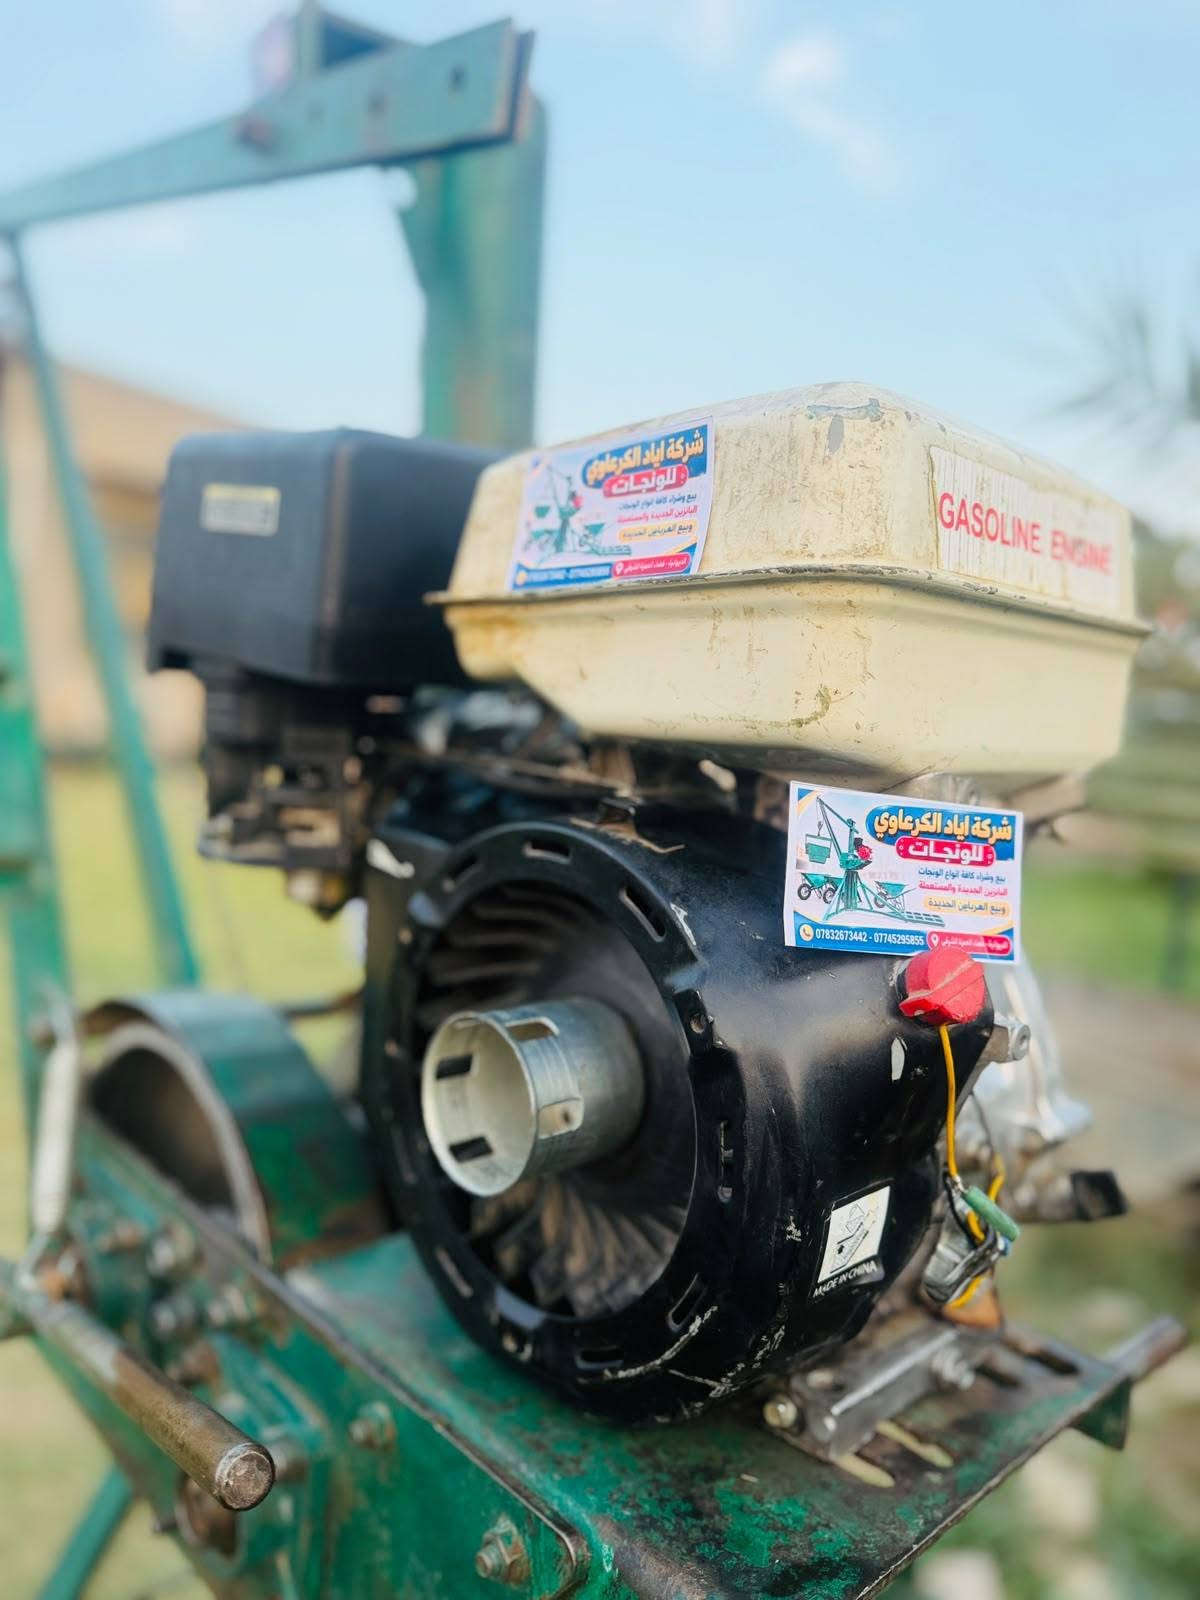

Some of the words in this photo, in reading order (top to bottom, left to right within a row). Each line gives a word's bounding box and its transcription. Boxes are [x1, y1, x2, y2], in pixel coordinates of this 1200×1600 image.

[643, 440, 666, 468] اياد
[667, 429, 704, 463] شركة
[611, 467, 677, 494] للونجات
[938, 492, 1041, 554] GASOLINE
[1051, 529, 1113, 576] ENGINE
[874, 808, 942, 839] الكرعاوي
[943, 813, 970, 841] اياد
[971, 816, 1012, 845] شركة
[908, 840, 985, 865] للونجات
[961, 869, 975, 879] كافة
[976, 871, 994, 883] وشراء
[995, 875, 1007, 884] بيع
[815, 928, 868, 942] 07832673442
[873, 932, 925, 945] 07745295855
[812, 1277, 839, 1298] MADE
[839, 1273, 849, 1284] IN
[848, 1260, 878, 1280] CHINA
